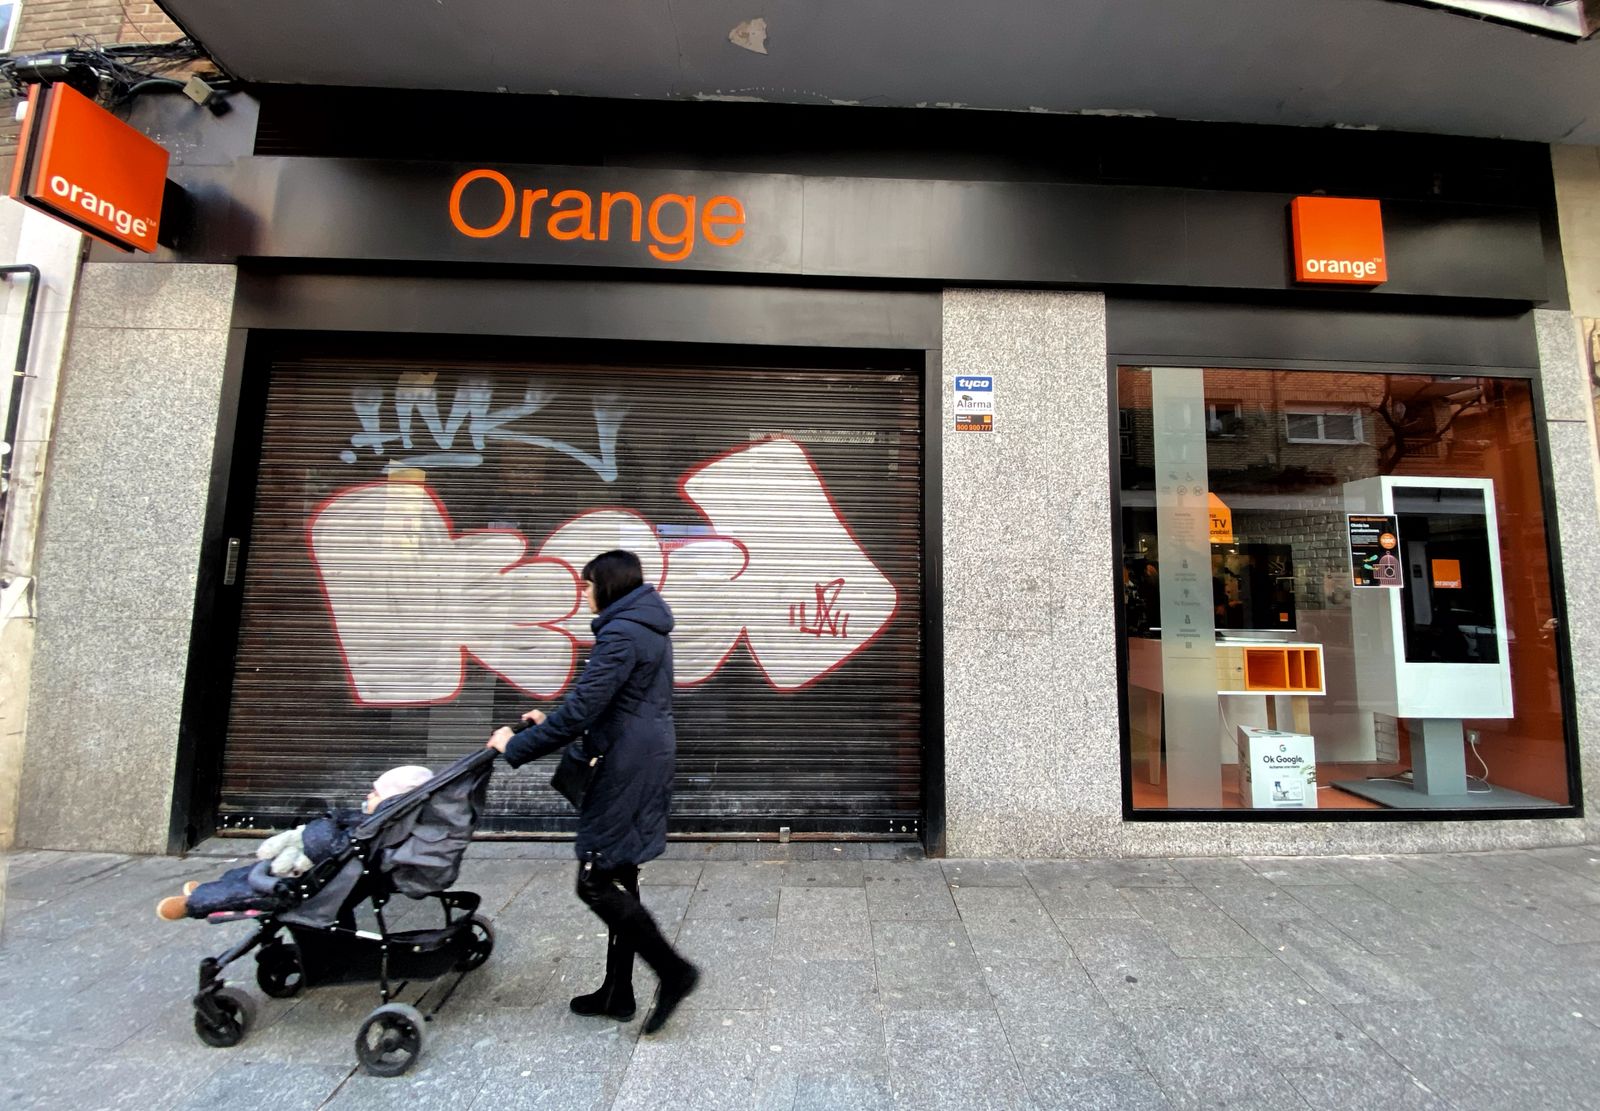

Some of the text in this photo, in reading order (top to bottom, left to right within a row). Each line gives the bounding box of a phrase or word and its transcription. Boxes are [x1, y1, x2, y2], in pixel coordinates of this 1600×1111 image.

[50, 175, 148, 237] orange
[449, 168, 747, 262] Orange
[1306, 258, 1377, 278] orange
[958, 378, 989, 389] tyco
[956, 399, 992, 408] Alarma
[1212, 519, 1227, 528] TV
[1263, 755, 1275, 763] Ok
